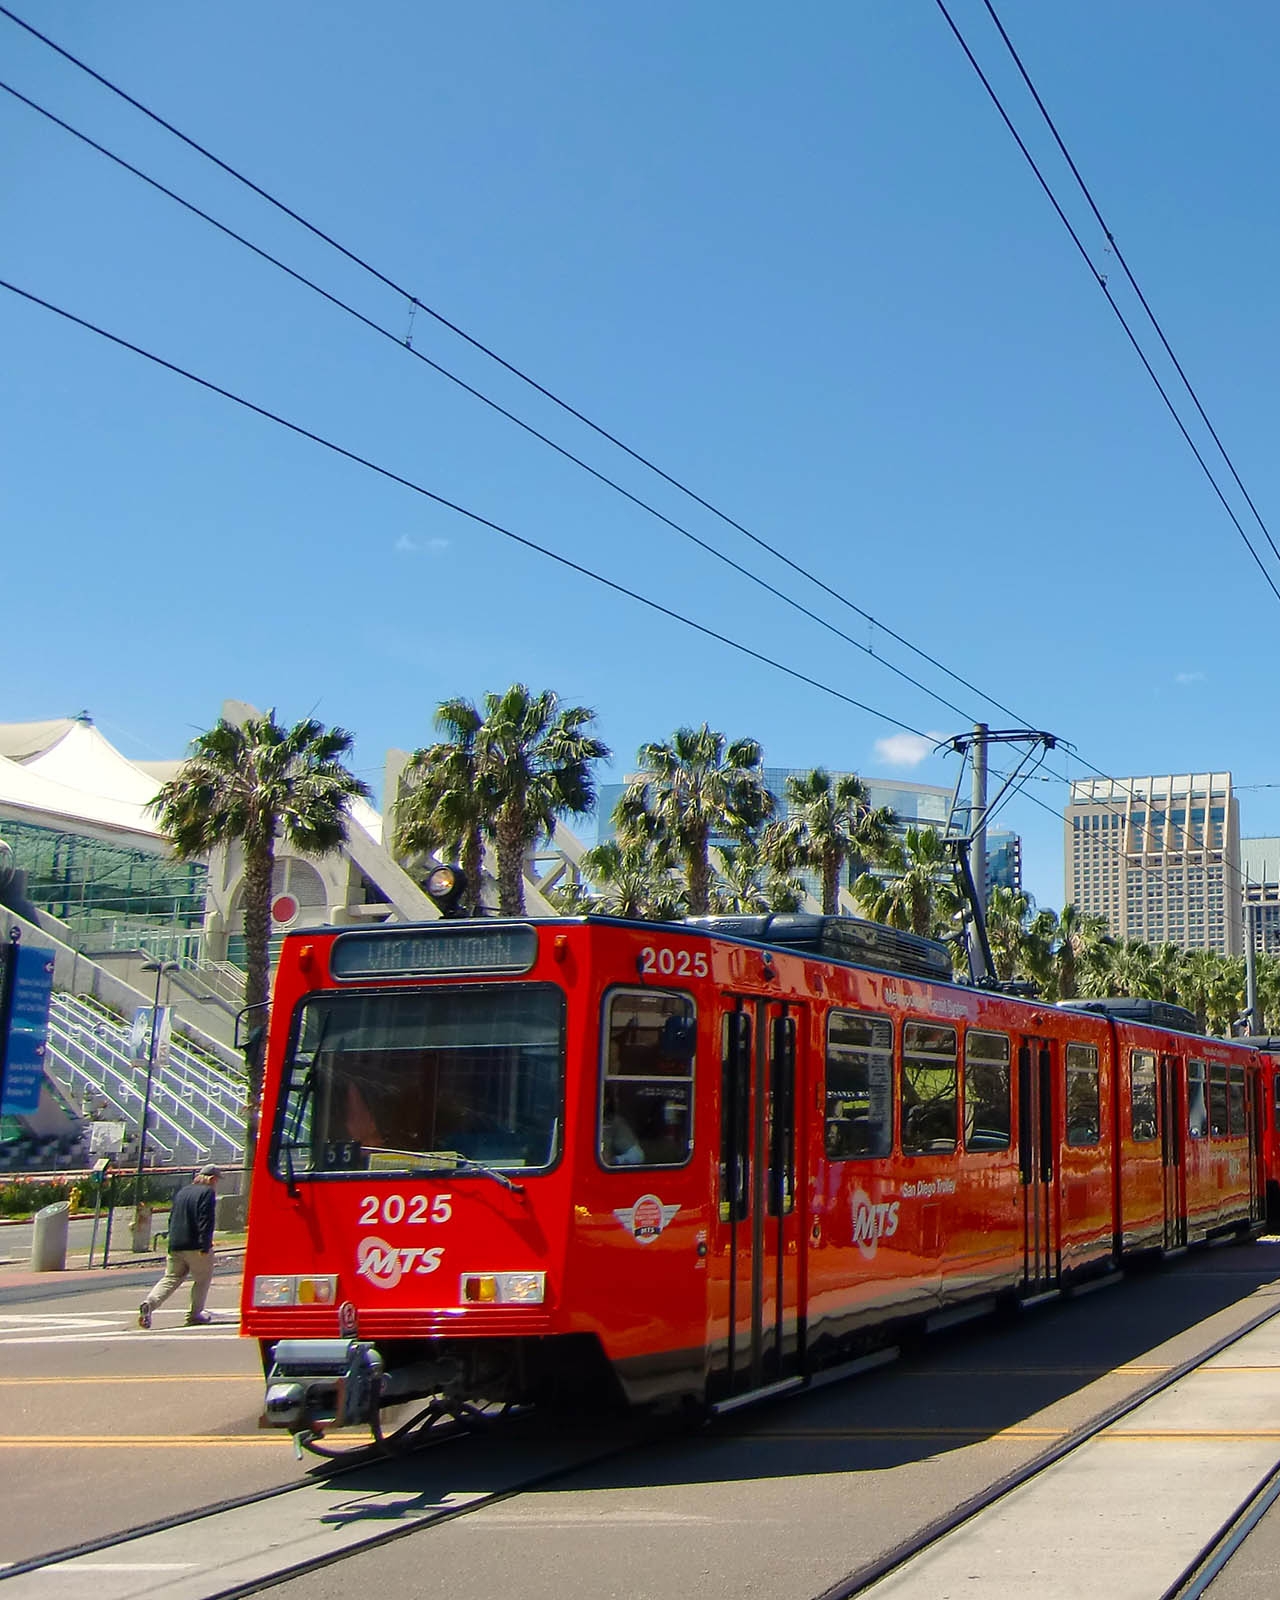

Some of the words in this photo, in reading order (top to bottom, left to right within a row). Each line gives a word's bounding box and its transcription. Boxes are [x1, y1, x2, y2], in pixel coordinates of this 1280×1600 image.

[410, 934, 513, 967] DOWNTOWN
[641, 946, 709, 978] 2025
[902, 1182, 916, 1198] San
[917, 1180, 936, 1198] Diego
[358, 1193, 453, 1225] 2025
[852, 1201, 900, 1242] MTS
[356, 1247, 446, 1275] MTS
